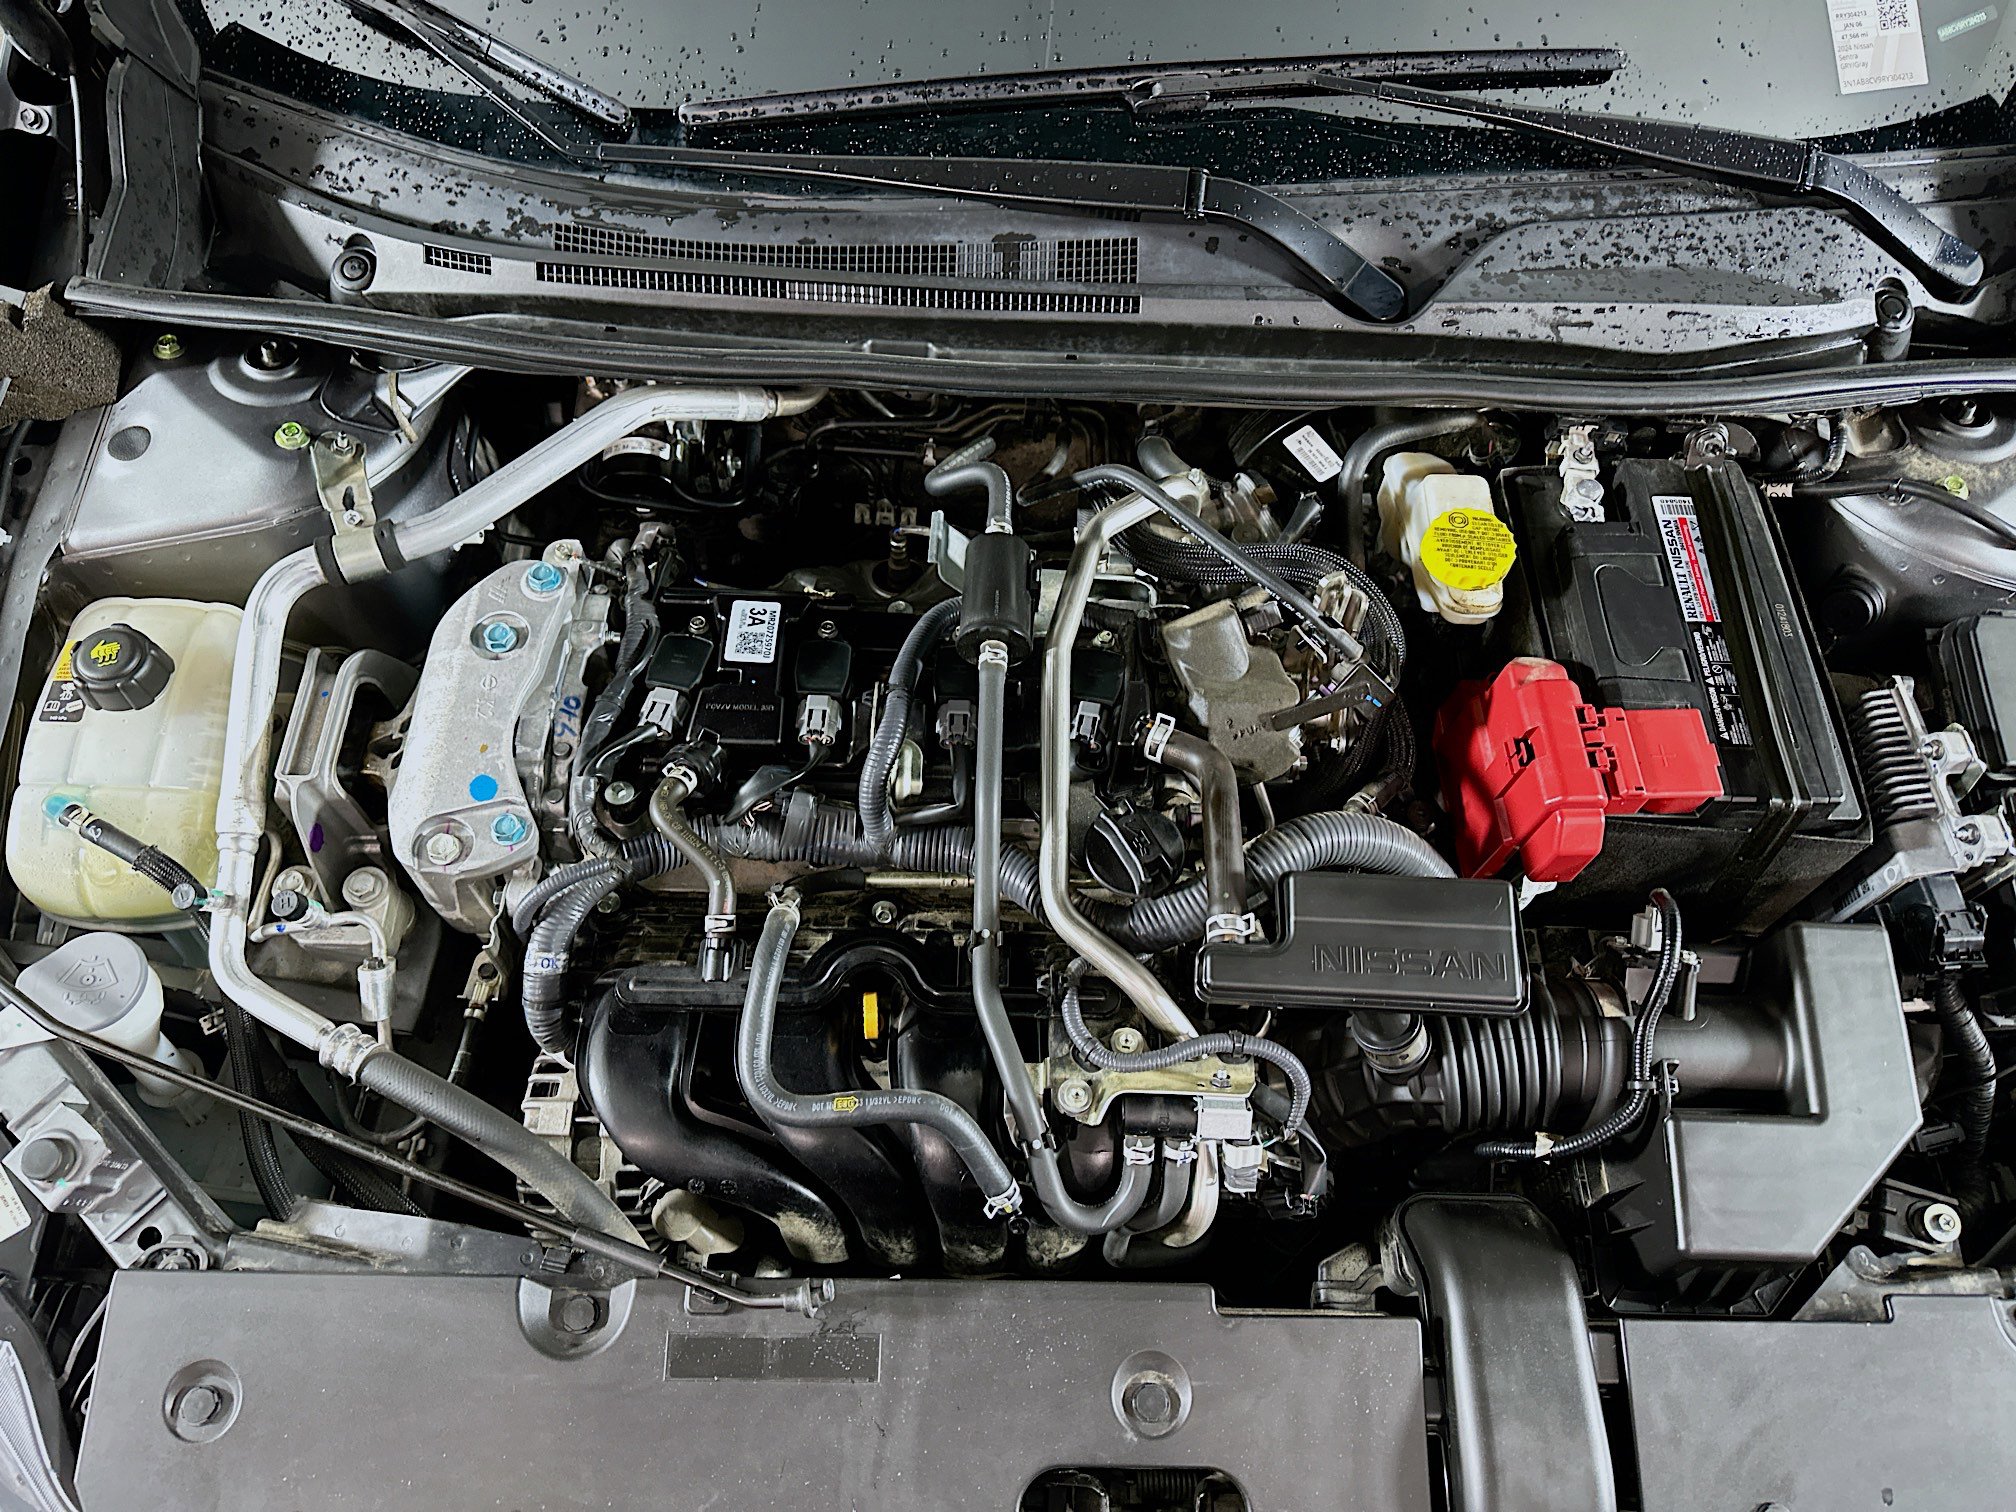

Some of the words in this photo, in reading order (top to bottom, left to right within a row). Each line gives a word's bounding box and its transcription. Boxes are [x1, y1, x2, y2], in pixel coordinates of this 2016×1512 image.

[1662, 519, 1684, 569] NISSAN
[1676, 572, 1698, 619] RENAULT
[747, 608, 767, 626] 3A
[1708, 687, 1726, 731] DANGER/POISON
[541, 958, 558, 969] OK
[1312, 944, 1508, 982] NISSAN
[812, 1103, 824, 1112] DOT
